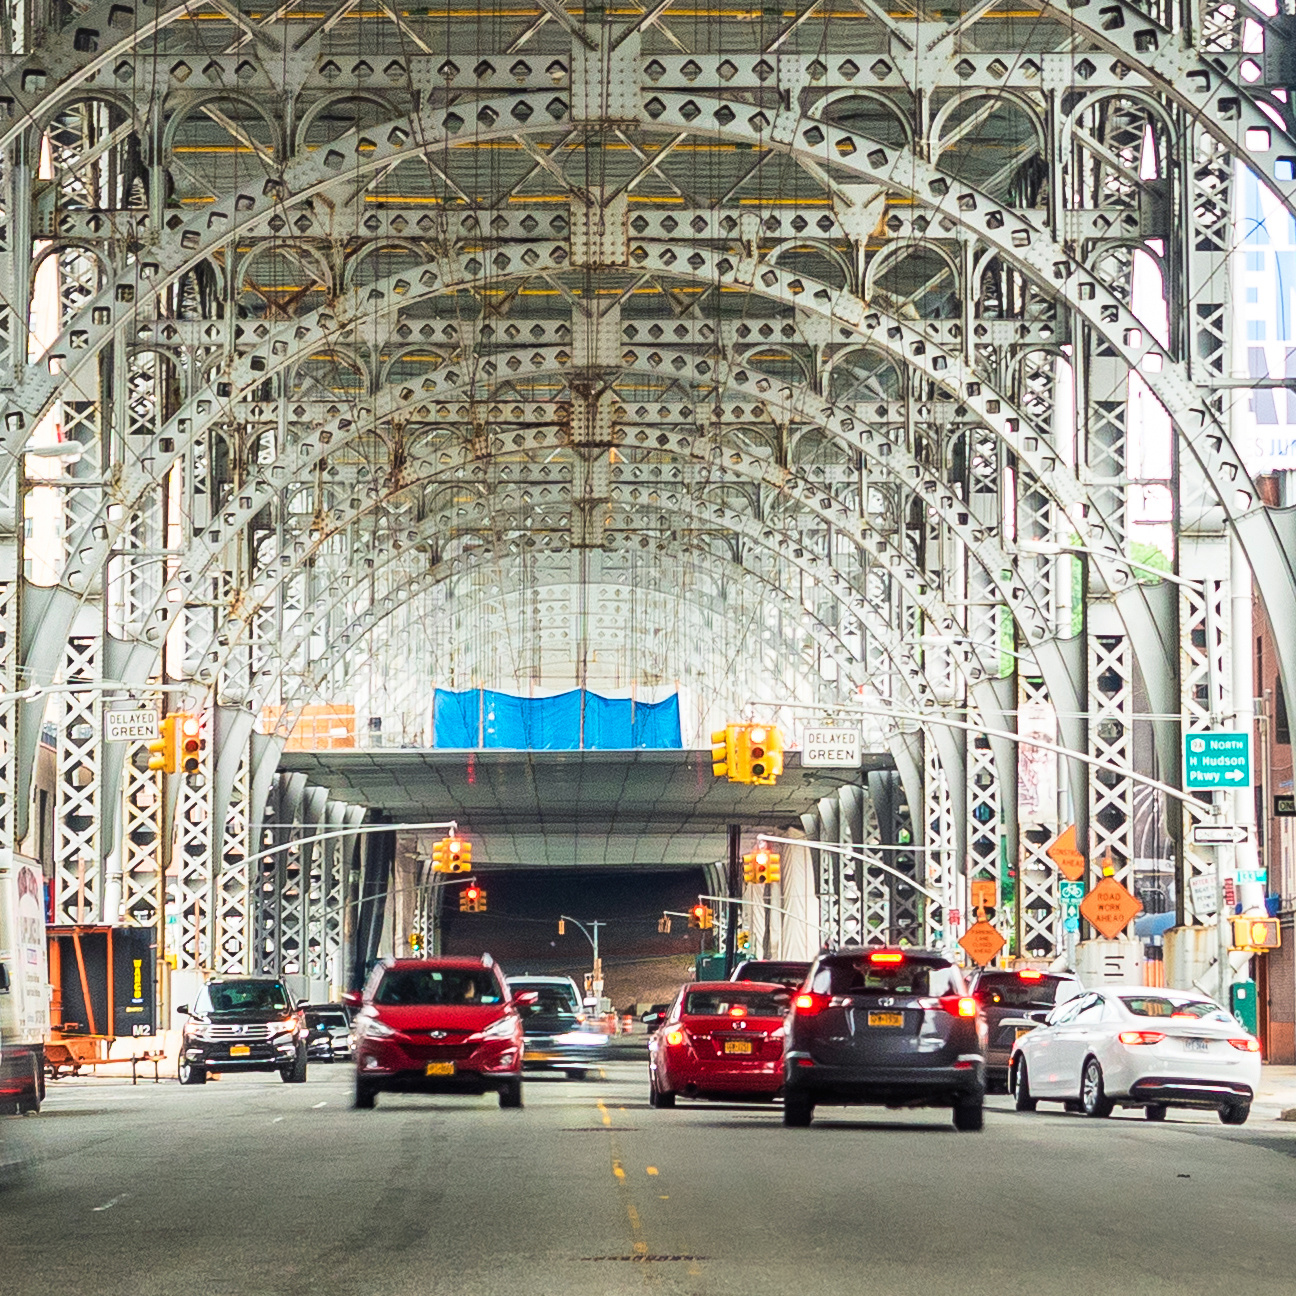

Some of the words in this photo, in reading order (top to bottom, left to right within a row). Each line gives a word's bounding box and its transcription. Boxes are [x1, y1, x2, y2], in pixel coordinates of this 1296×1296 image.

[109, 713, 154, 724] DELAYED
[111, 726, 154, 736] GREEN
[808, 733, 855, 743] DELAYED
[808, 749, 854, 760] GREEN
[1201, 755, 1246, 766] Hudson
[1189, 770, 1221, 783] Pkwy
[1097, 893, 1121, 901] ROAD
[132, 1024, 151, 1036] M2
